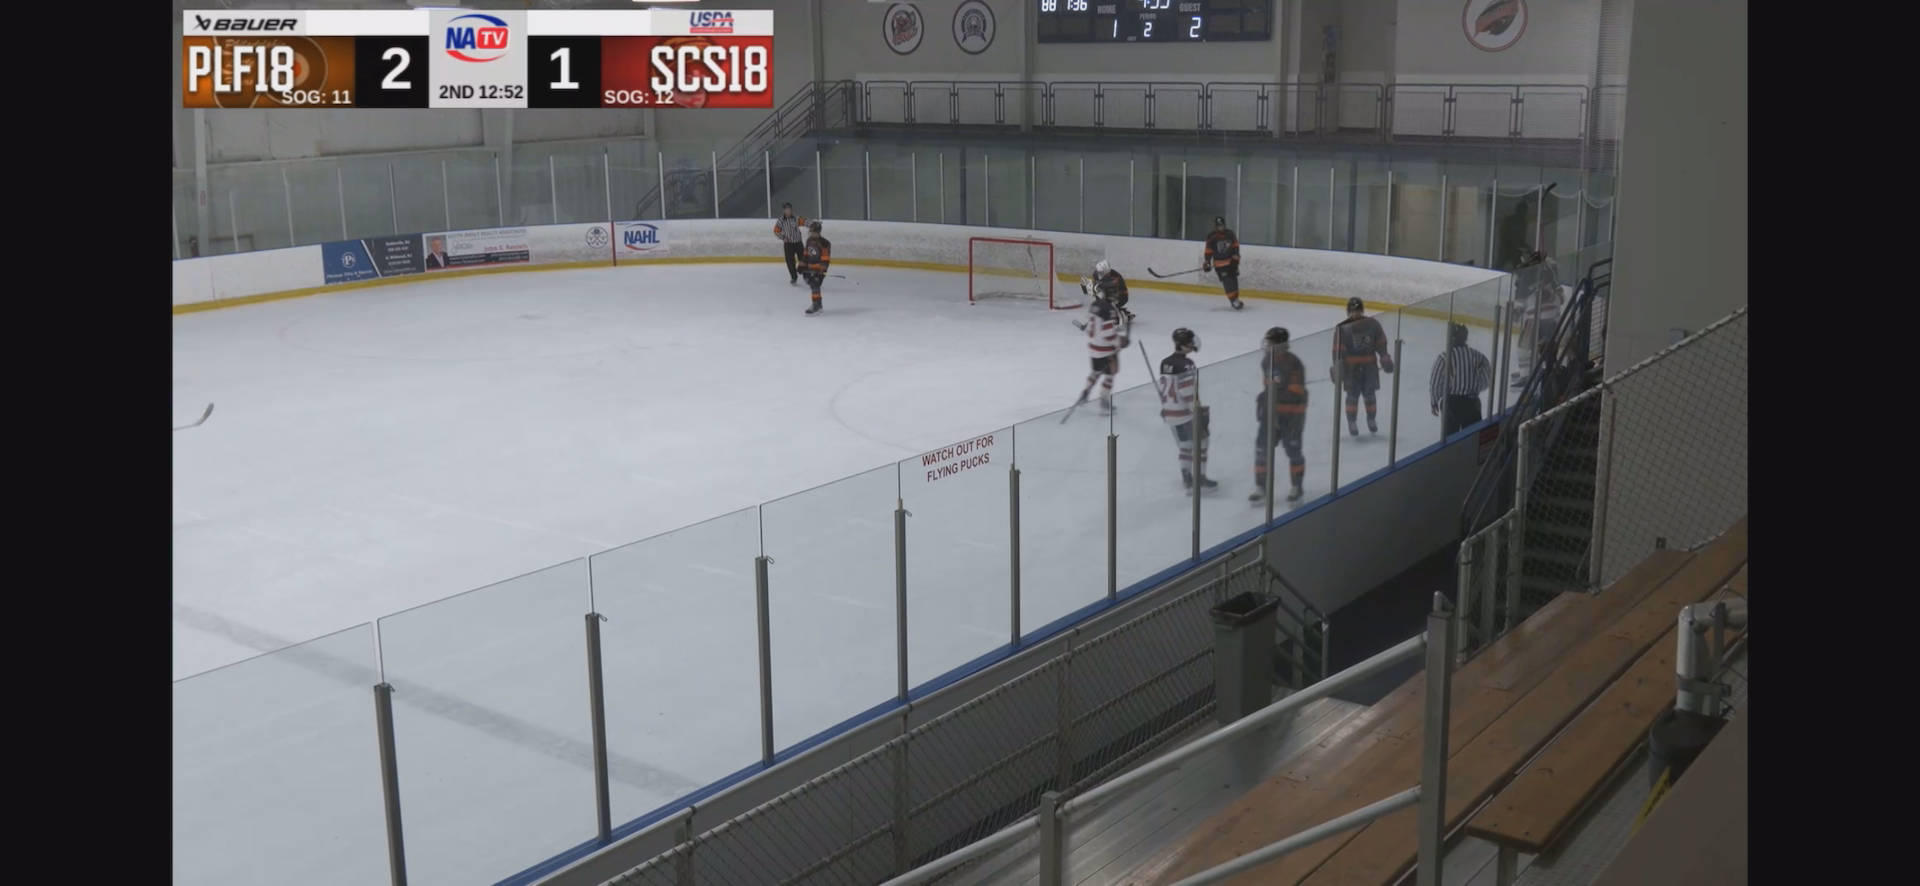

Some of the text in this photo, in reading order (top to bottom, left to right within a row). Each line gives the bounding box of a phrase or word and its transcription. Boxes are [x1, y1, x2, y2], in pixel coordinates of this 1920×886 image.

[1097, 5, 1117, 14] HOME
[1179, 3, 1201, 12] GUEST
[1112, 19, 1118, 38] 1
[1143, 22, 1153, 37] 2
[1189, 16, 1202, 38] 2
[624, 229, 660, 245] NAHL
[1160, 375, 1179, 404] 24
[922, 435, 994, 467] WATCH OUT FOR
[927, 452, 990, 483] FLYING PUCKS
